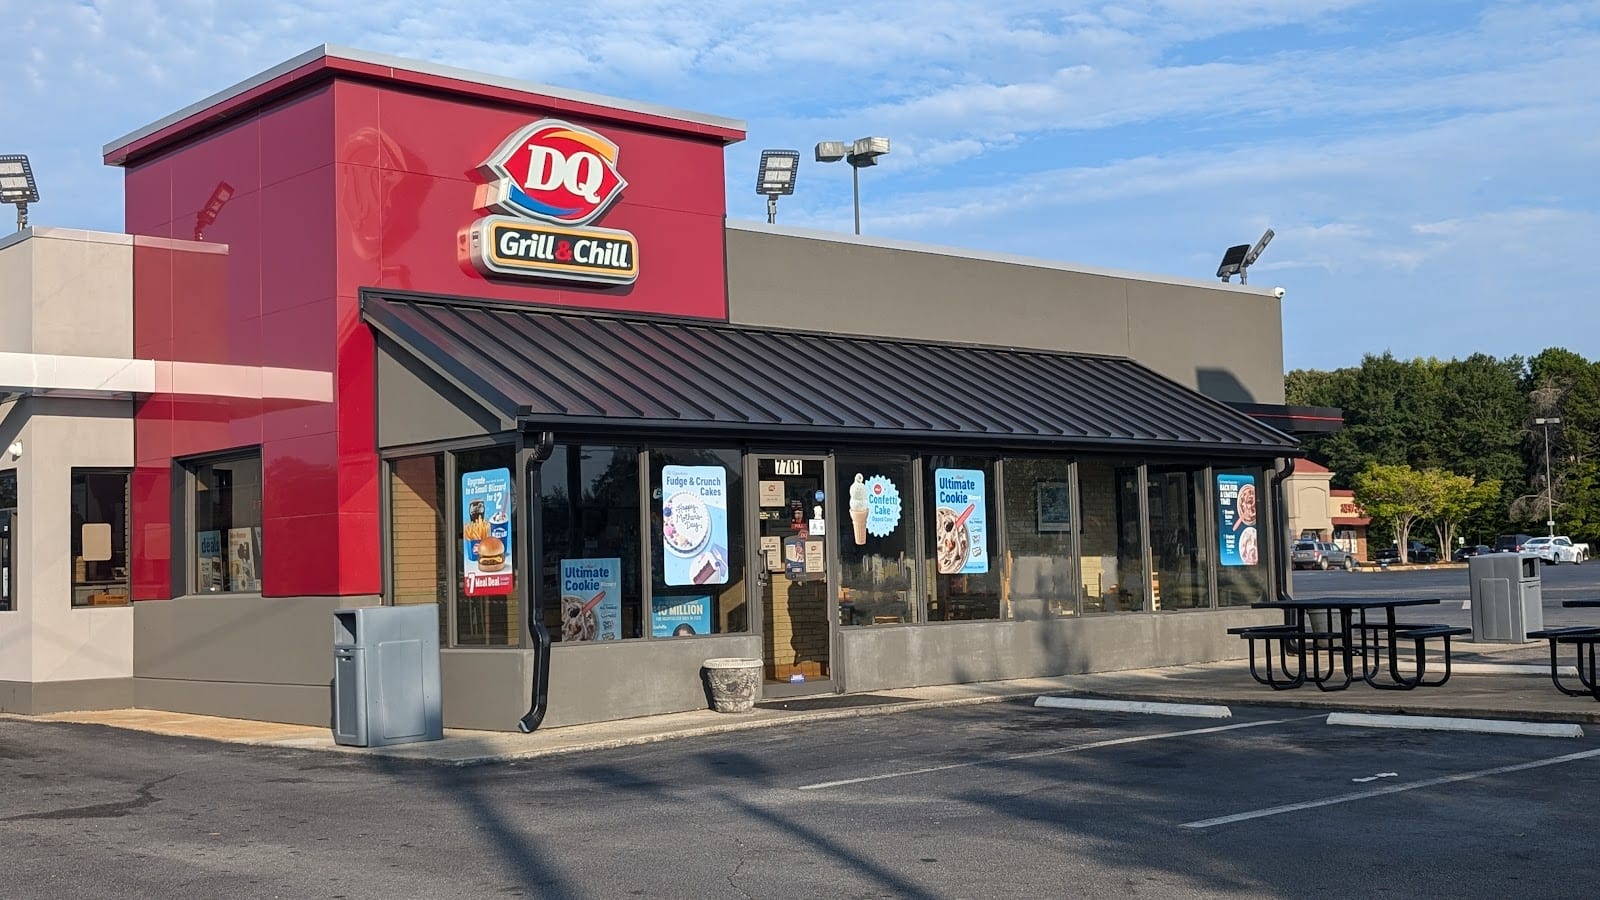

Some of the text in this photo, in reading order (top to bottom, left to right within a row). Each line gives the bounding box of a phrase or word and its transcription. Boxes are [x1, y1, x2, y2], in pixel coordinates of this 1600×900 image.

[525, 144, 603, 204] DQ
[777, 460, 801, 474] 7701
[666, 476, 721, 488] Fudge & Crunch
[939, 476, 975, 490] Ultimate
[700, 487, 721, 497] Cakes
[939, 491, 968, 504] Cookie
[868, 494, 898, 505] Confetti
[874, 505, 891, 515] Cake
[565, 566, 609, 579] Ultimate
[476, 577, 488, 588] Meal
[488, 575, 500, 587] Deal
[565, 579, 600, 592] Cookie
[669, 604, 703, 616] MILLION
